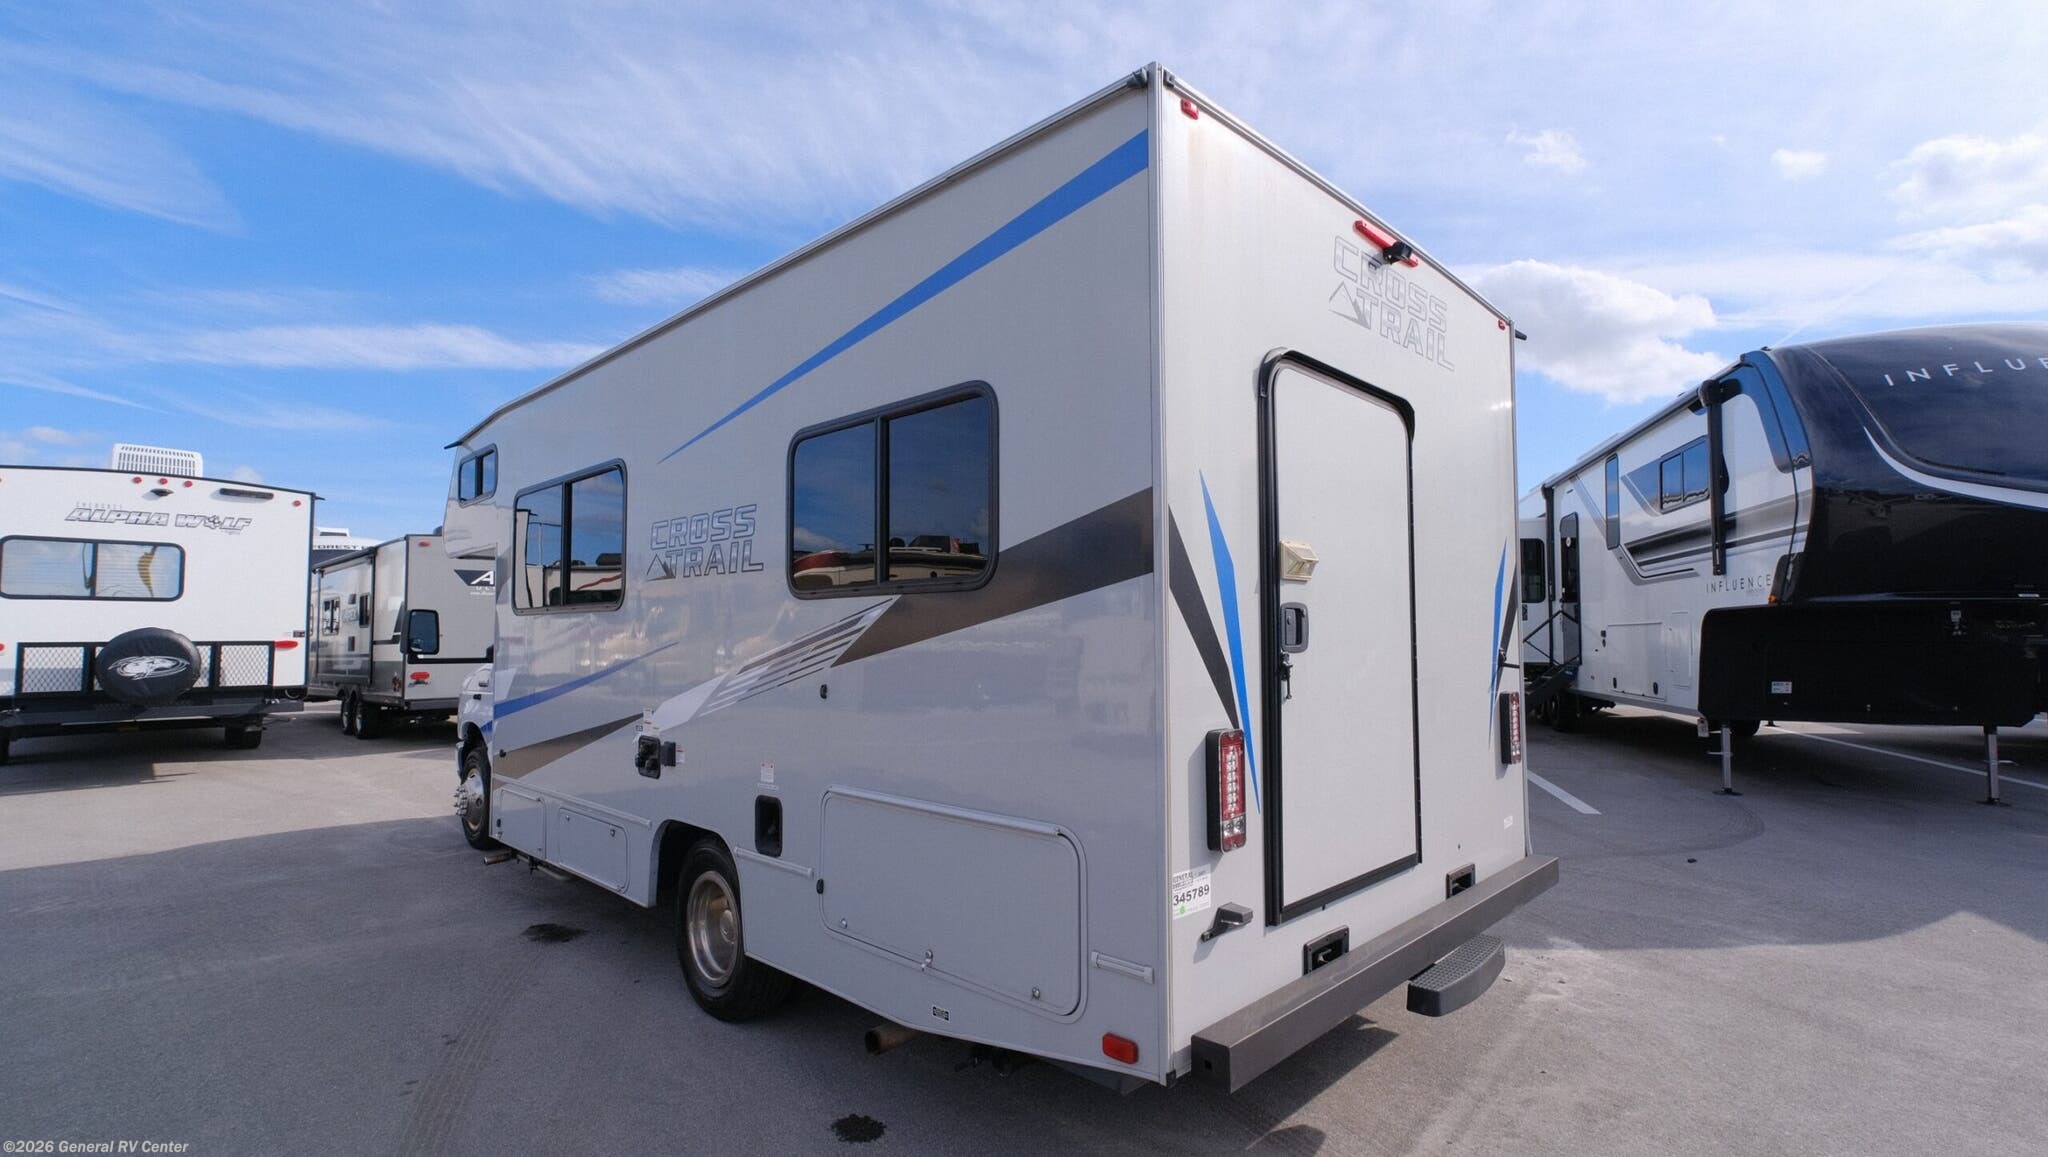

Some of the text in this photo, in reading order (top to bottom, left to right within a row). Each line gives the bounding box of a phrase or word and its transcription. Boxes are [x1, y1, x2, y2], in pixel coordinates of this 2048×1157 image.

[1333, 235, 1447, 334] CROSS
[1356, 286, 1455, 371] TRAIL
[64, 507, 170, 526] ALPHA
[650, 503, 757, 551] CROSS
[664, 540, 764, 579] TRAIL
[1705, 574, 1771, 593] INFLUENCE
[1173, 884, 1210, 906] 345789
